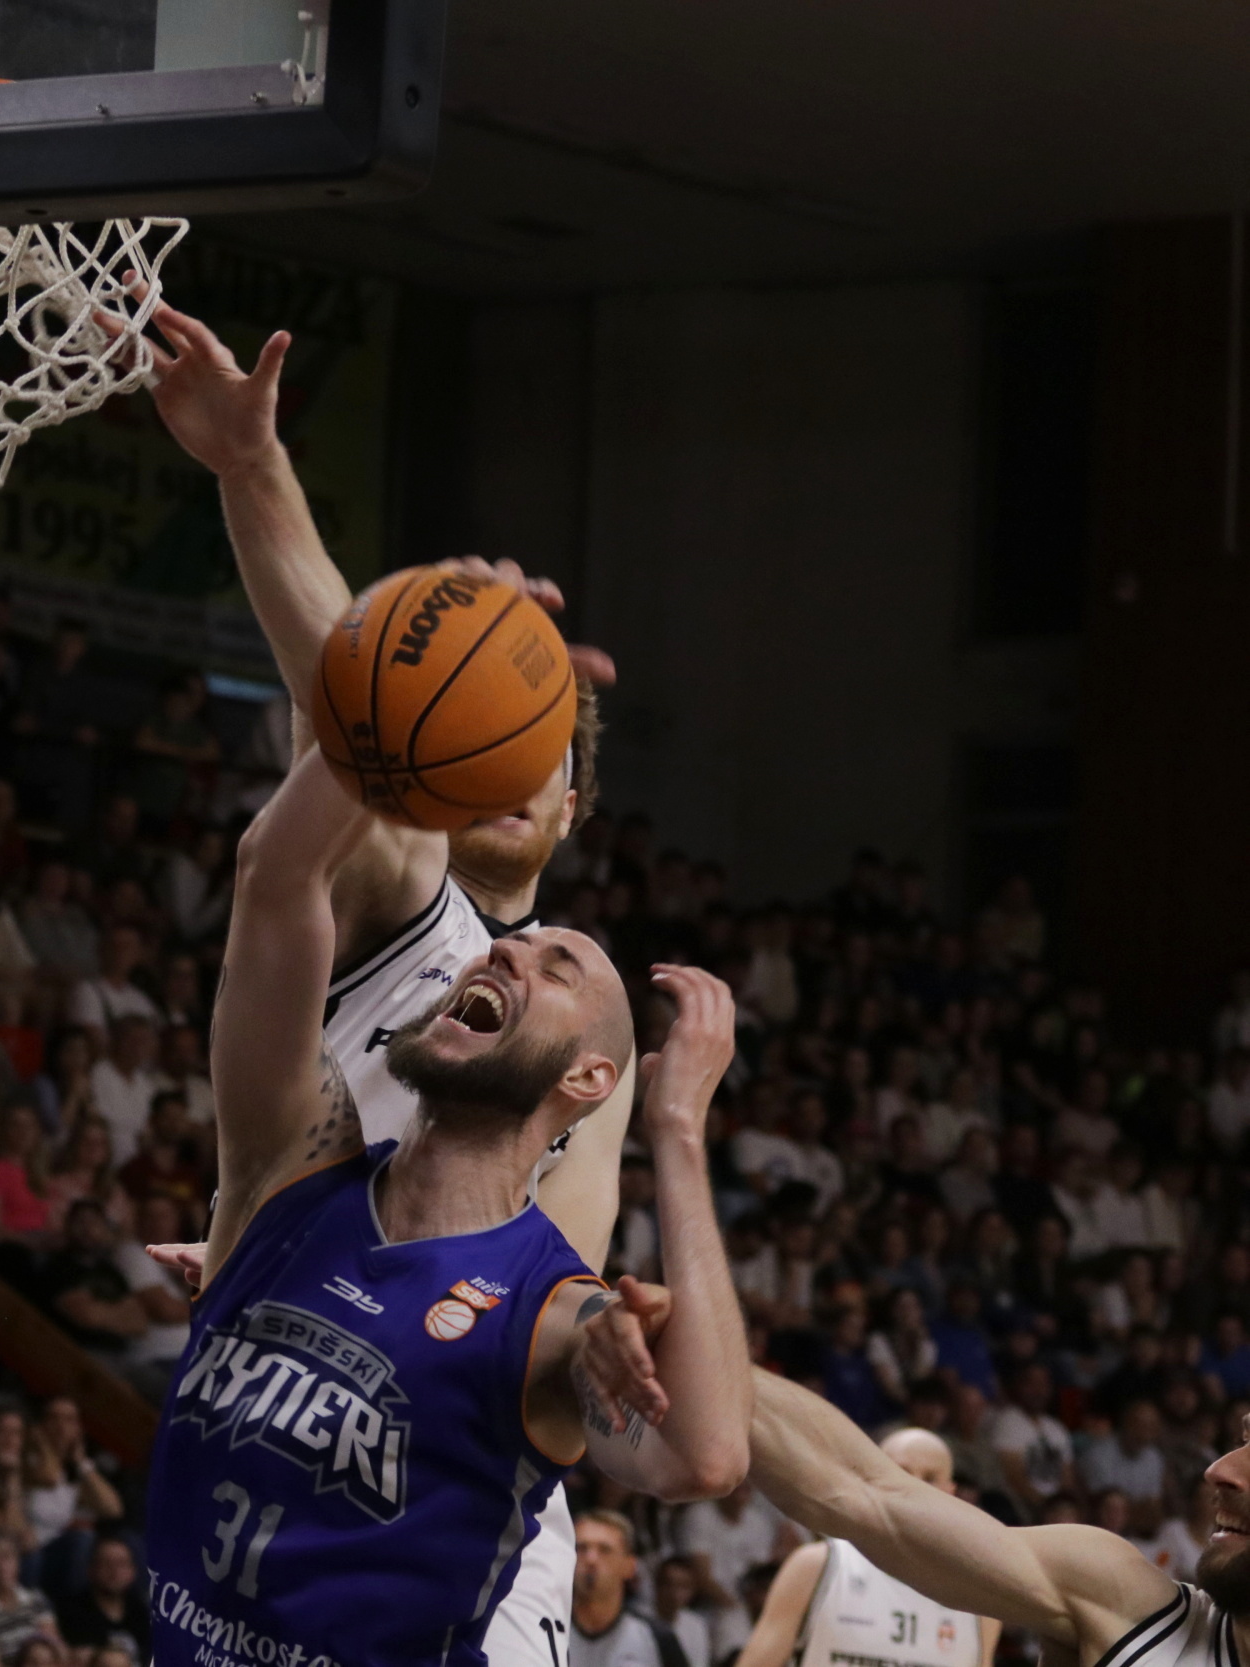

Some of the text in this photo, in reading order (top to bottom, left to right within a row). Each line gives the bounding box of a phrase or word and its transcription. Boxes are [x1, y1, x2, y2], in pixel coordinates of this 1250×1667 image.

[0, 490, 142, 582] 1995
[200, 1479, 286, 1600] 31
[890, 1609, 917, 1646] 31
